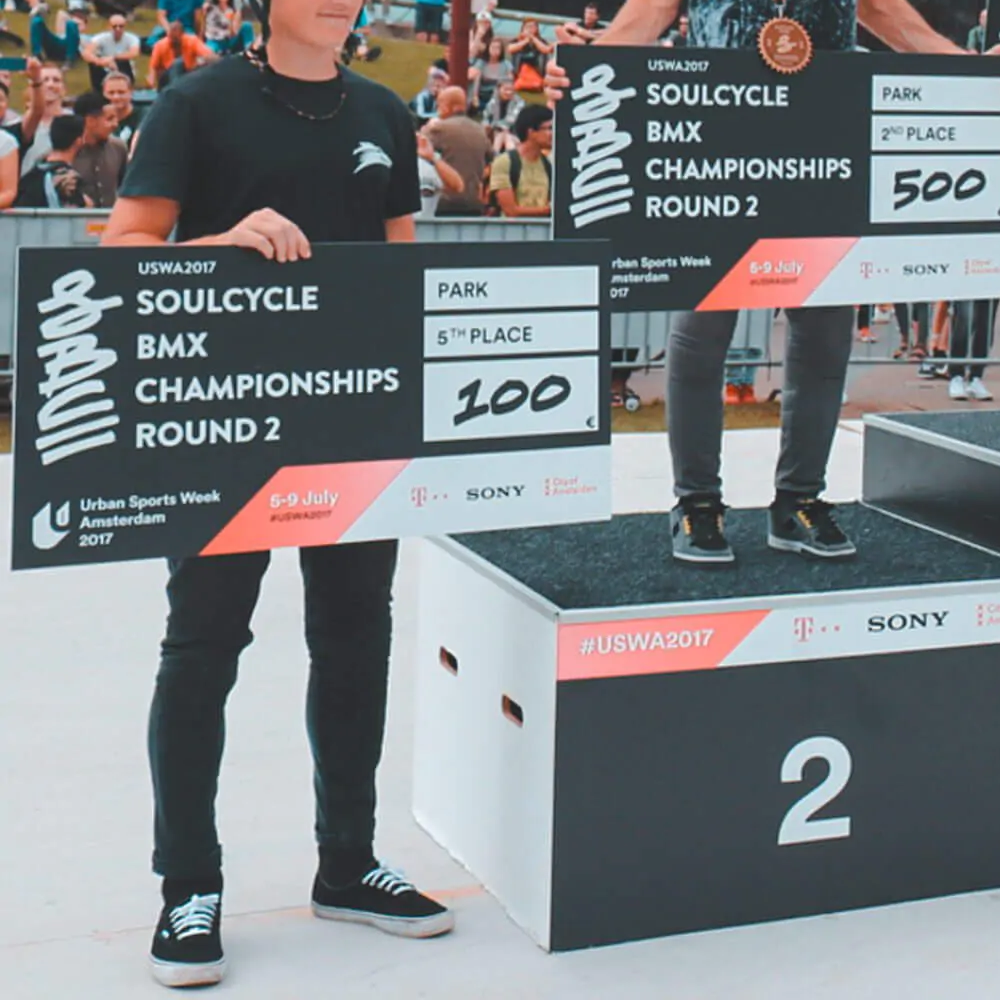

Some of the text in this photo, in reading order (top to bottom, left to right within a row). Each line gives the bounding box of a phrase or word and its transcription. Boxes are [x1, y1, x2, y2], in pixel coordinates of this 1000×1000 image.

[648, 59, 710, 72] USWA2017
[647, 83, 789, 107] SOULCYCLE
[882, 87, 922, 101] PARK
[647, 121, 702, 142] BMX
[907, 127, 956, 142] PLACE
[645, 158, 852, 180] CHAMPIONSHIPS
[893, 168, 986, 211] 500
[646, 195, 759, 218] ROUND 2
[137, 260, 217, 275] USWA2017
[611, 255, 711, 271] rban Sports Week
[774, 259, 804, 276] July
[902, 263, 949, 276] SONY
[611, 270, 670, 283] msterdam
[438, 281, 489, 299] PARK
[609, 287, 629, 299] 017
[136, 285, 319, 315] SOULCYCLE
[470, 326, 533, 344] PLACE
[136, 332, 209, 360] BMX
[135, 367, 400, 404] CHAMPIONSHIPS
[453, 374, 572, 426] 100
[135, 416, 281, 449] ROUND 2
[80, 489, 221, 512] Urban Sports Week
[302, 489, 339, 507] July
[466, 485, 525, 501] SONY
[79, 511, 166, 530] Amsterdam
[79, 532, 113, 548] 2017
[868, 611, 950, 633] SONY
[579, 629, 715, 656] #USWA2017
[777, 735, 854, 846] 2
